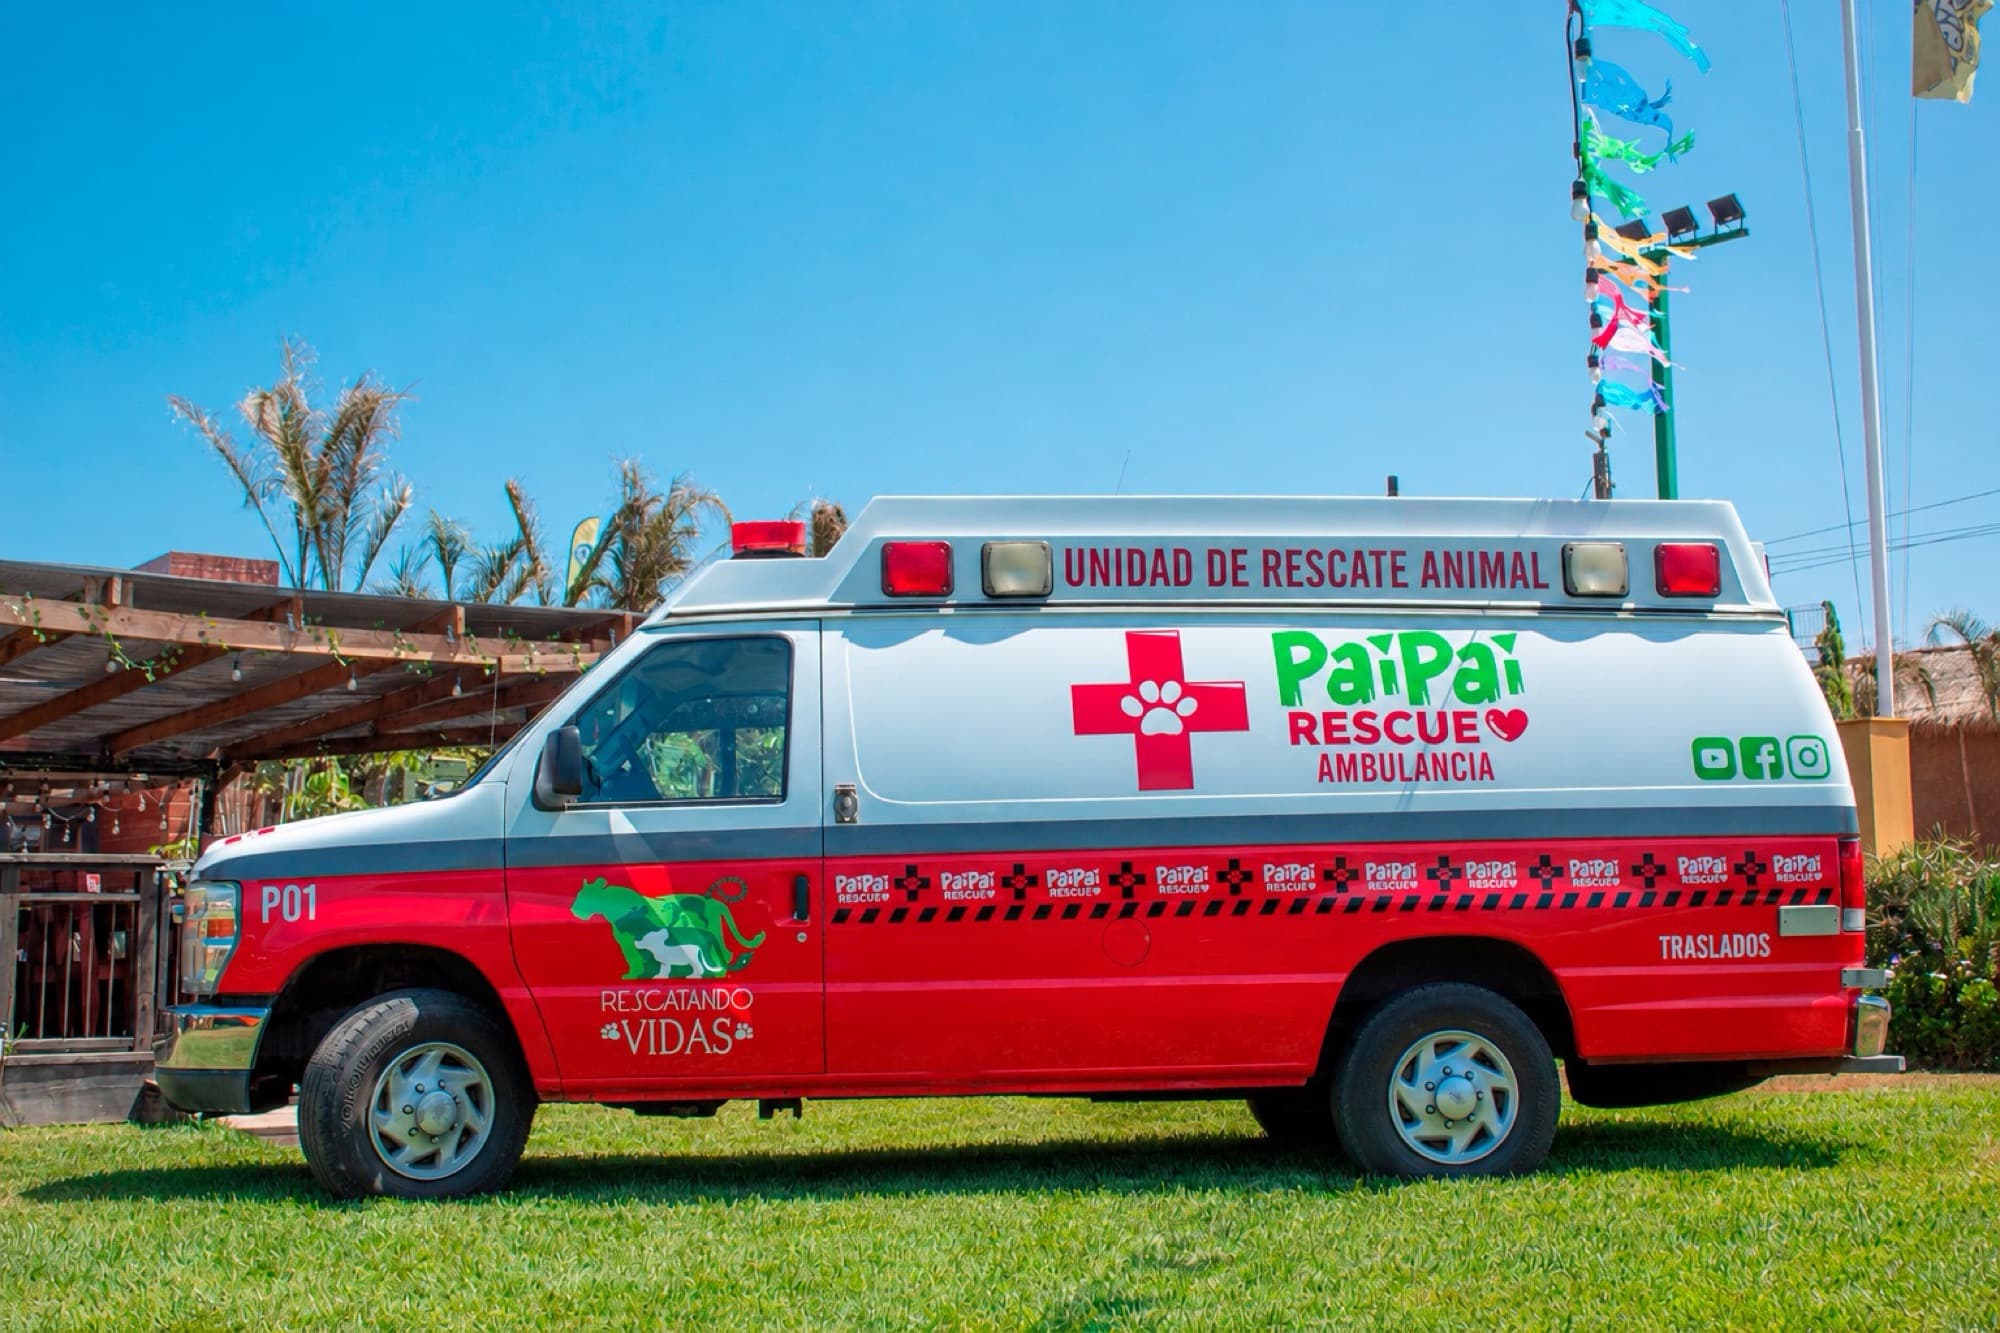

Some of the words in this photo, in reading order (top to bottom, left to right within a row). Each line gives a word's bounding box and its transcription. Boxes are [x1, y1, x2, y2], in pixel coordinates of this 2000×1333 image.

[1064, 547, 1193, 588] UNIDAD
[1207, 548, 1250, 588] DE
[1262, 548, 1409, 589] RESCATE
[1420, 550, 1549, 590] ANIMAL
[1288, 710, 1481, 746] RESCUE
[1318, 751, 1495, 783] AMBULANCIA
[1572, 876, 1612, 888] RESCUE
[1681, 874, 1720, 884] RESCUE
[1776, 872, 1814, 882] RESCUE
[1158, 884, 1201, 894] RESCUE
[1266, 881, 1308, 892] RESCUE
[1368, 879, 1410, 891] RESCUE
[1469, 878, 1509, 889] RESCUE
[839, 892, 881, 904] RESCUE
[944, 889, 986, 900] RESCUE
[1049, 886, 1092, 898] RESCUE
[1659, 933, 1770, 959] TRASLADOS
[601, 988, 754, 1013] RESCATANDO
[622, 1018, 733, 1055] VIDAS
